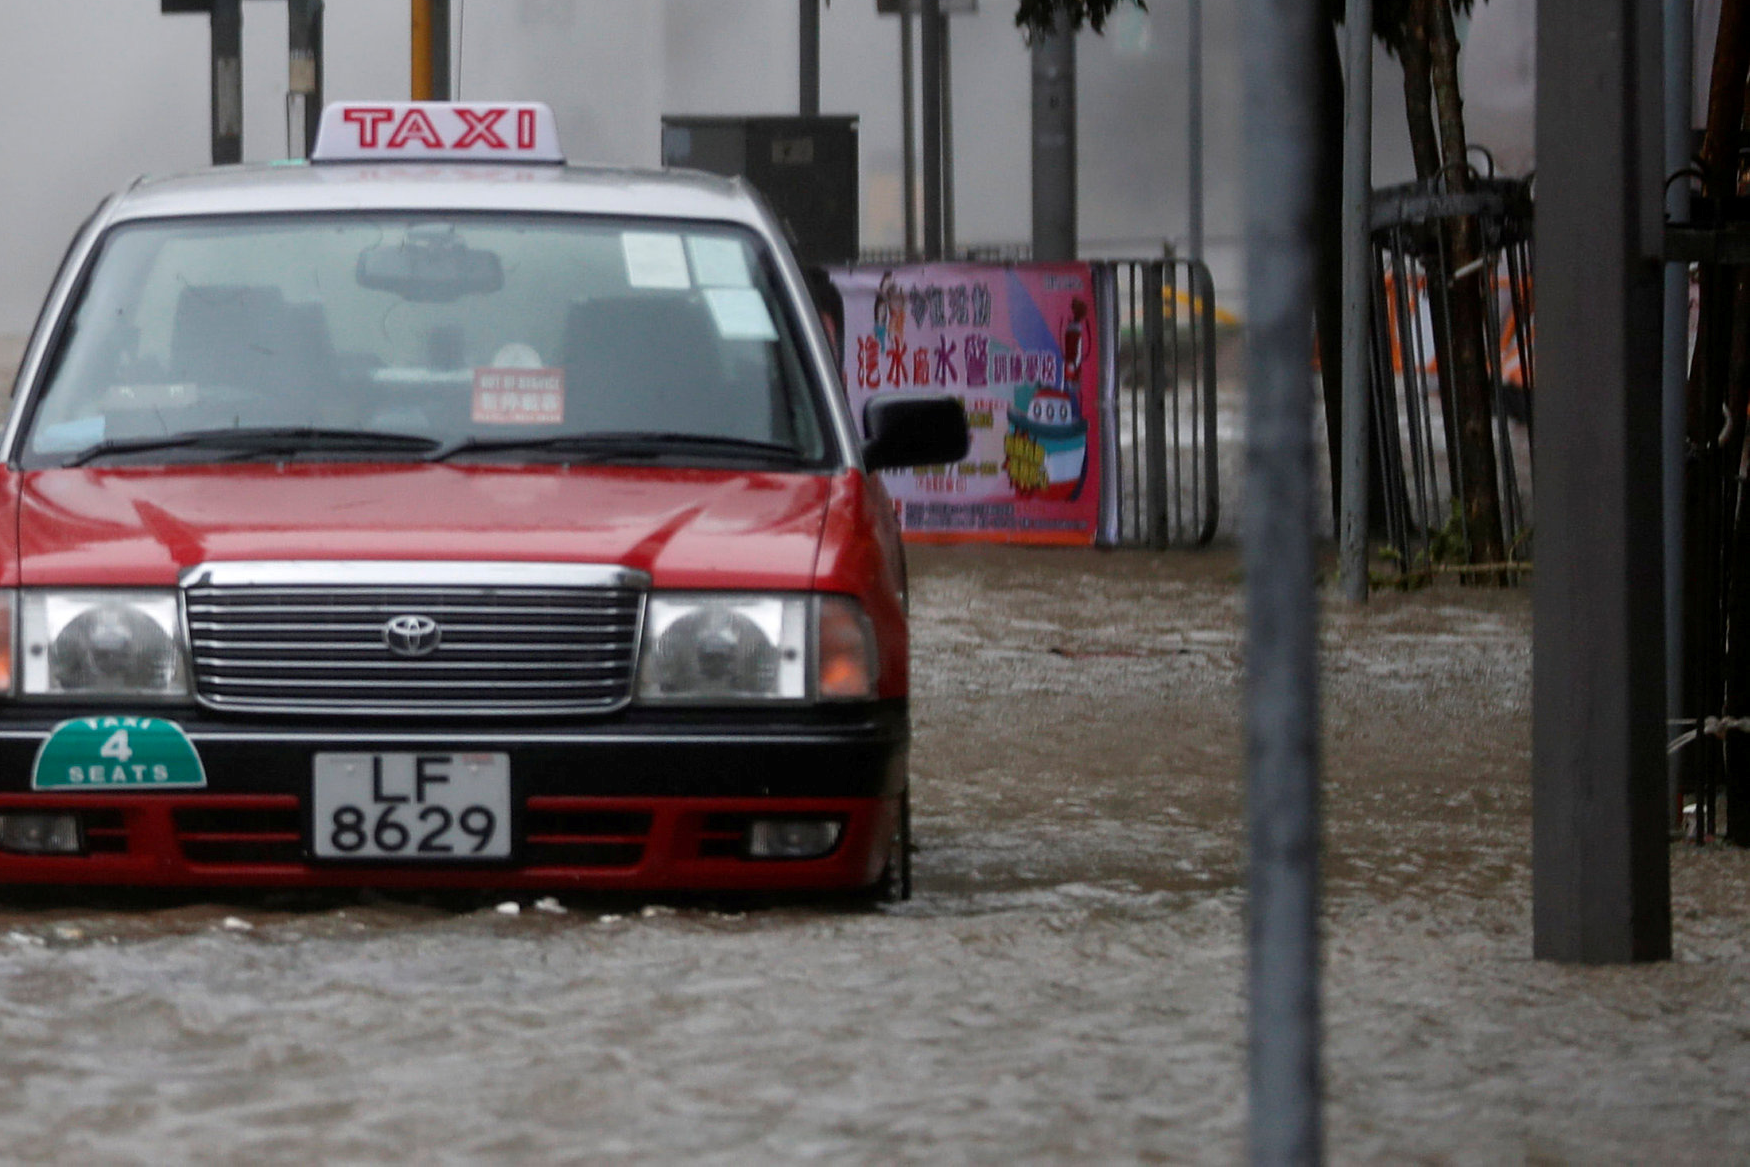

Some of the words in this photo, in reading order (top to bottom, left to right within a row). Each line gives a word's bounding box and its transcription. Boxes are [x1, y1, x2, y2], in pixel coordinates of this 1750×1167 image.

[344, 108, 537, 150] TAXI
[100, 729, 133, 762] 4
[68, 764, 169, 783] SEATS
[373, 756, 453, 803] LF
[331, 805, 497, 852] 8629
